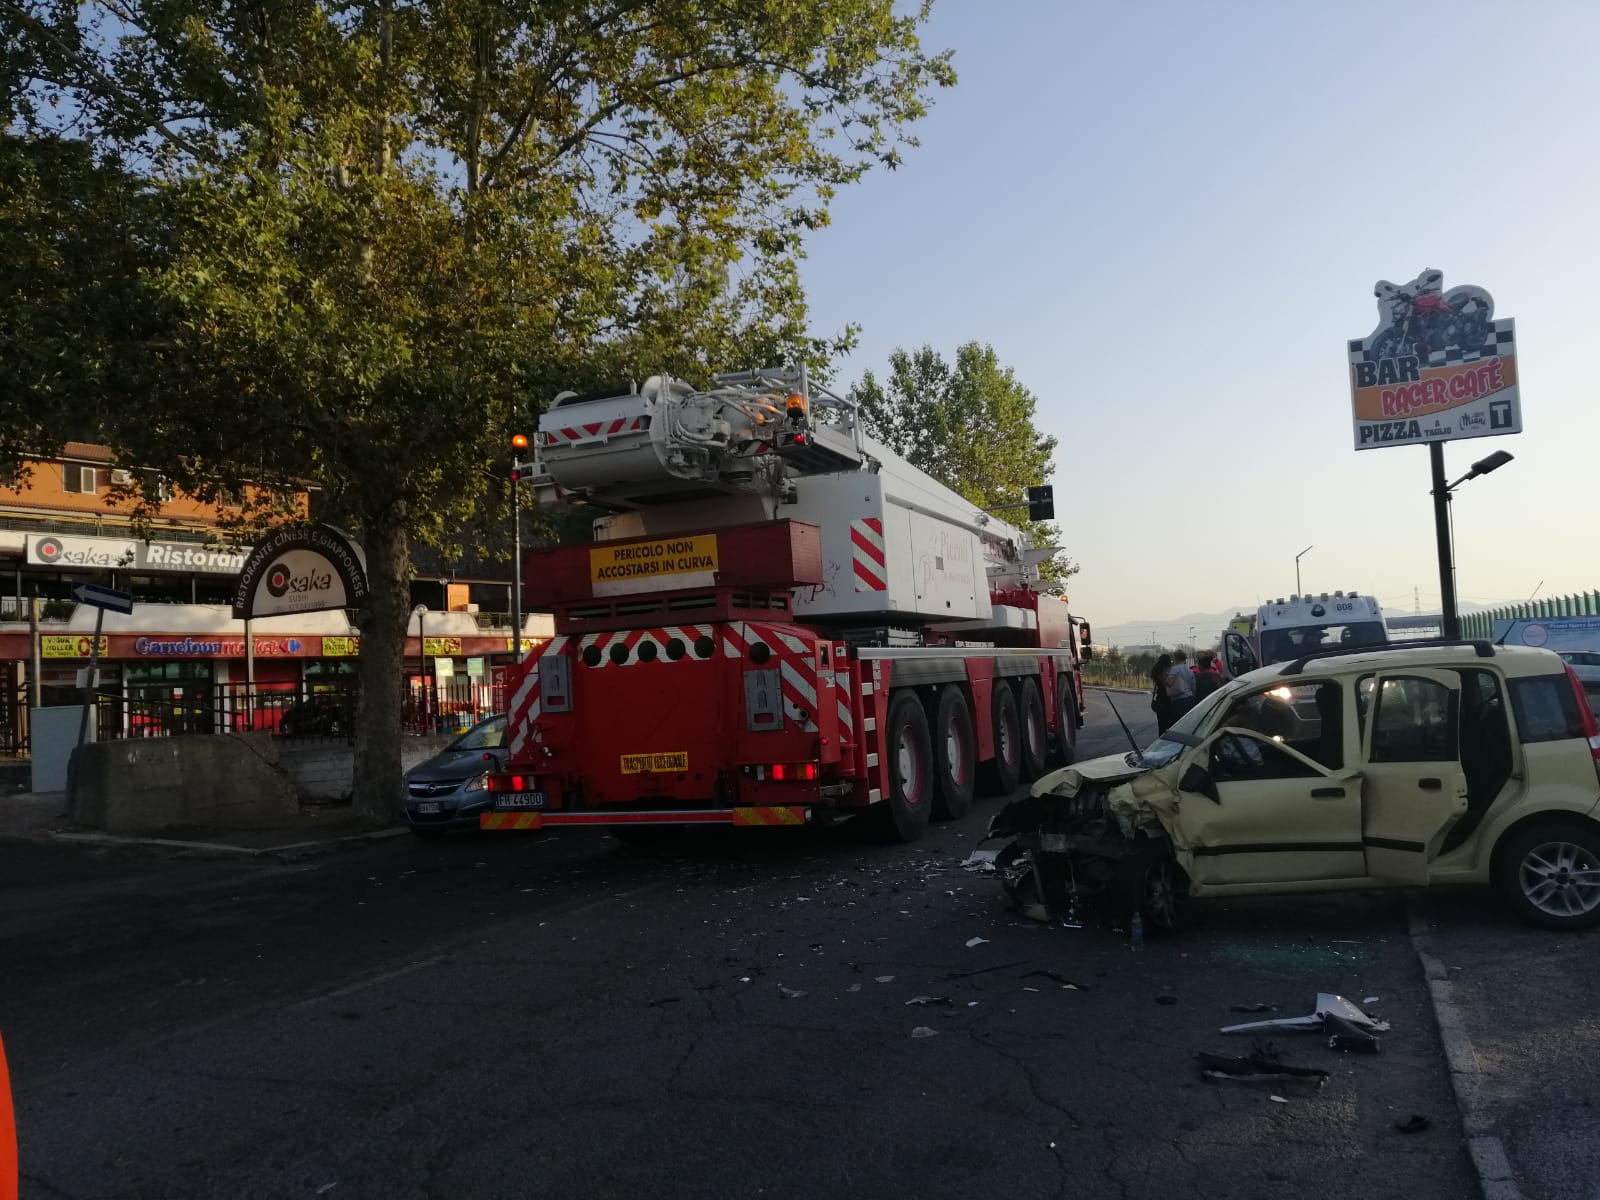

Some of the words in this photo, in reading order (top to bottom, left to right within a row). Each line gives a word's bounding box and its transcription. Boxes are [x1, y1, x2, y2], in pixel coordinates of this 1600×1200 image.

[1356, 355, 1420, 388] BAR
[1382, 378, 1450, 416] RACER
[1449, 357, 1505, 399] CAFÉ
[1491, 403, 1511, 427] T
[1359, 420, 1422, 444] PIZZA
[35, 536, 110, 566] Osaka
[614, 544, 664, 561] PERICOLO
[667, 541, 693, 555] NON
[236, 542, 274, 609] RISTORANTE
[274, 528, 311, 546] CINESE
[311, 530, 318, 542] E
[320, 535, 365, 599] GIAPPONESE
[267, 563, 331, 598] Osaka
[598, 560, 660, 579] ACCOSTARSI
[663, 559, 675, 573] IN
[678, 555, 714, 571] CURVA
[135, 636, 220, 655] Carrefour
[220, 640, 281, 656] maket
